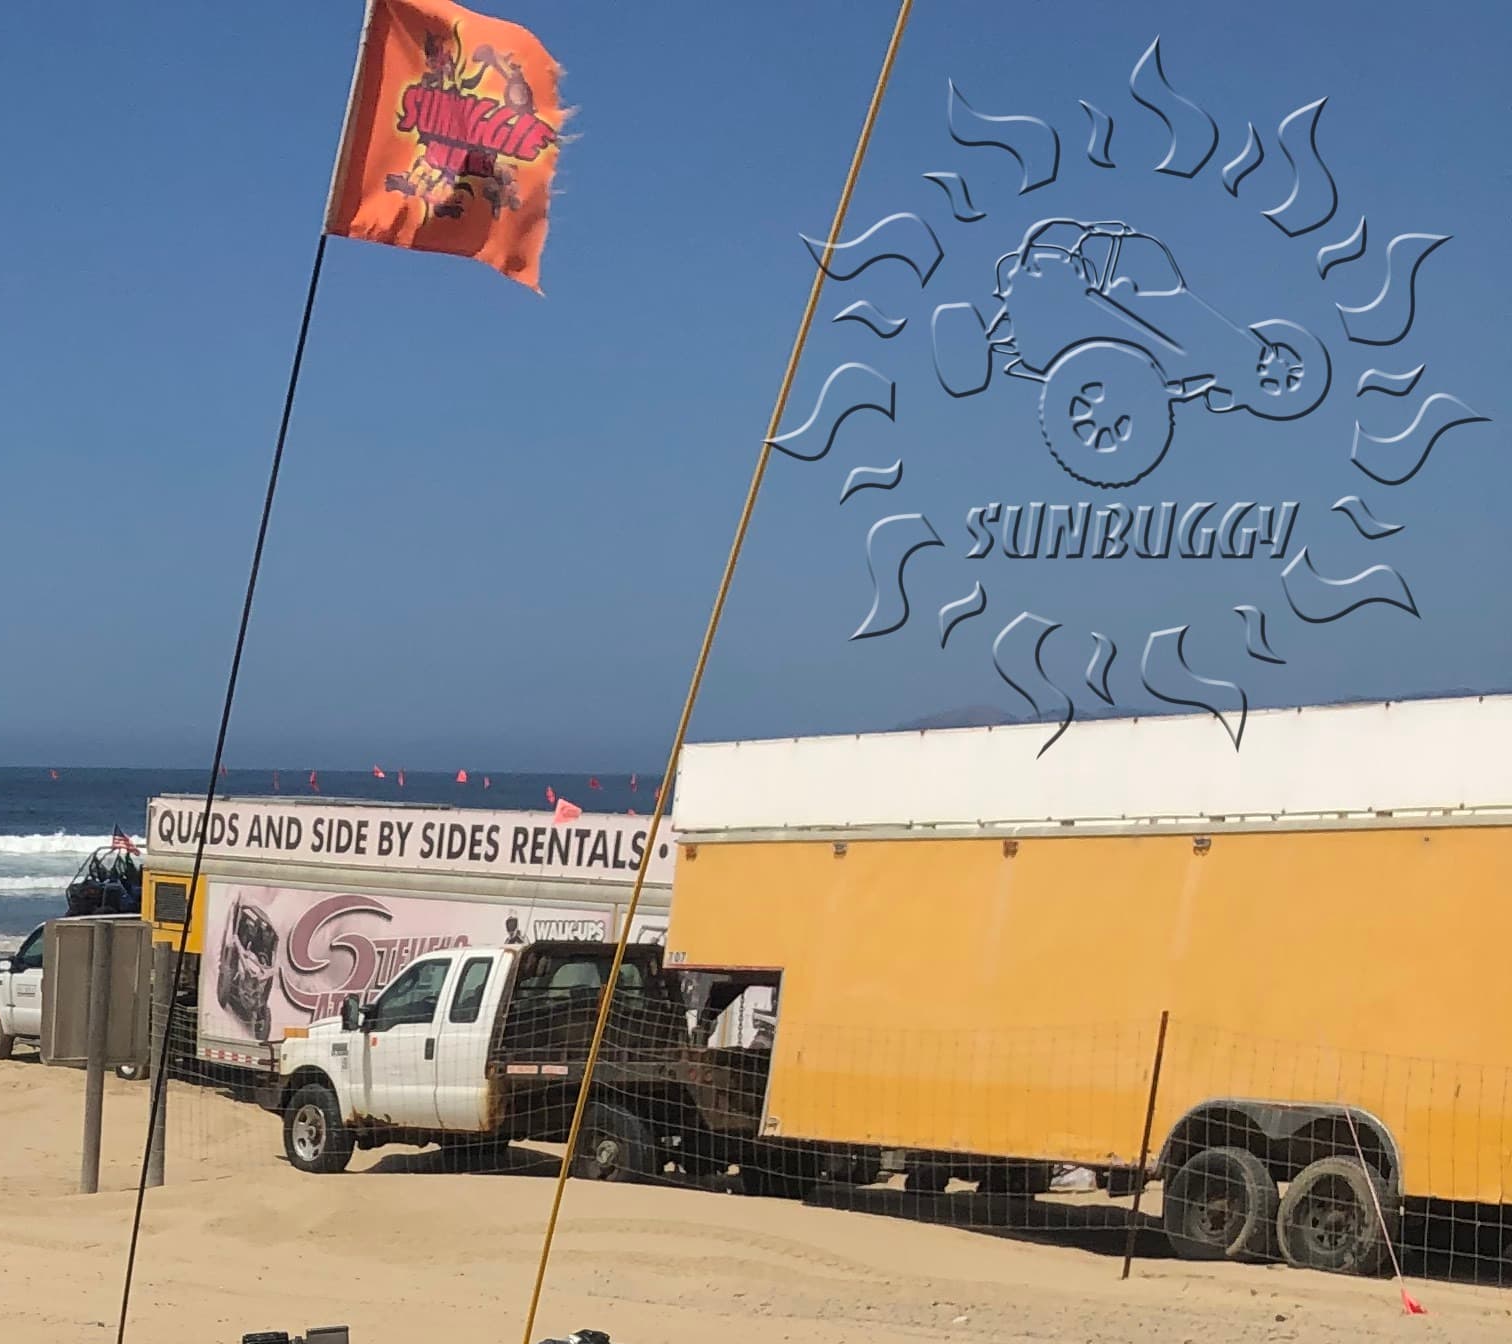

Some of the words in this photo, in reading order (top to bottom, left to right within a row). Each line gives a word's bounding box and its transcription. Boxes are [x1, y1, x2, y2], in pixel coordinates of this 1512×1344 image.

[158, 809, 240, 847] QUADS
[246, 814, 302, 850] AND
[311, 817, 369, 855] SIDE
[377, 821, 413, 857] BY
[420, 822, 500, 863] SIDES
[510, 826, 648, 871] RENTALS
[534, 919, 606, 943] WALK-UPS
